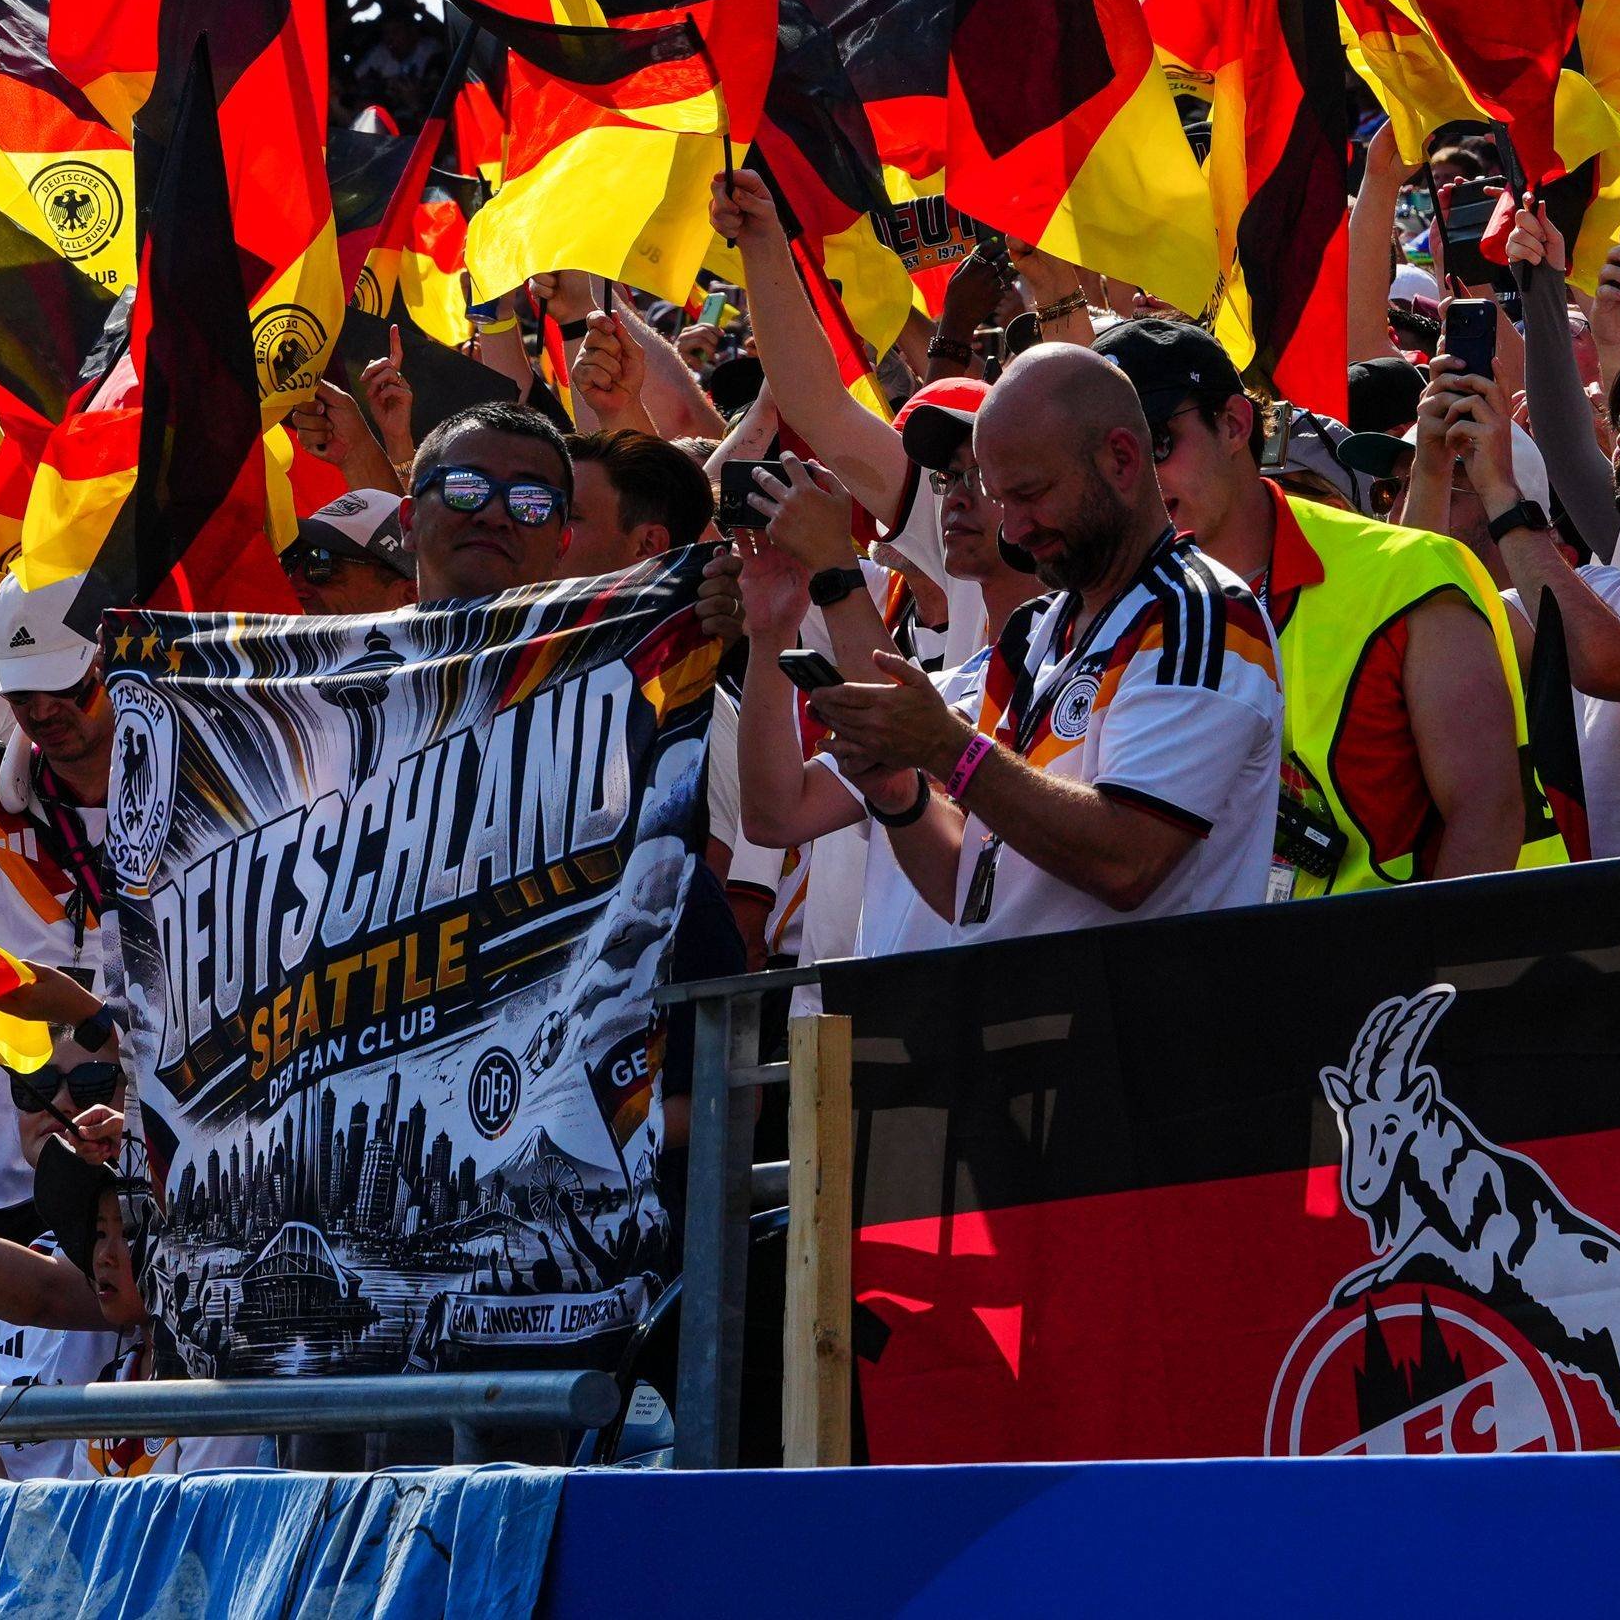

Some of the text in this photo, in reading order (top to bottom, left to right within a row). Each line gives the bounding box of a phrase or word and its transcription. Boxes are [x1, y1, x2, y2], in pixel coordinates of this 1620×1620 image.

[41, 173, 100, 194] DEUTSCHER
[59, 218, 108, 249] BALL-BUND
[936, 243, 966, 261] 1974
[9, 637, 36, 649] adidas
[113, 685, 165, 727] TSCHER
[150, 658, 634, 1073] DEUTSCHLAND
[250, 912, 471, 1082] SEATTLE
[267, 1005, 437, 1109] DFB FAN CLUB
[478, 1065, 513, 1123] DFB
[1420, 1380, 1499, 1454] FC
